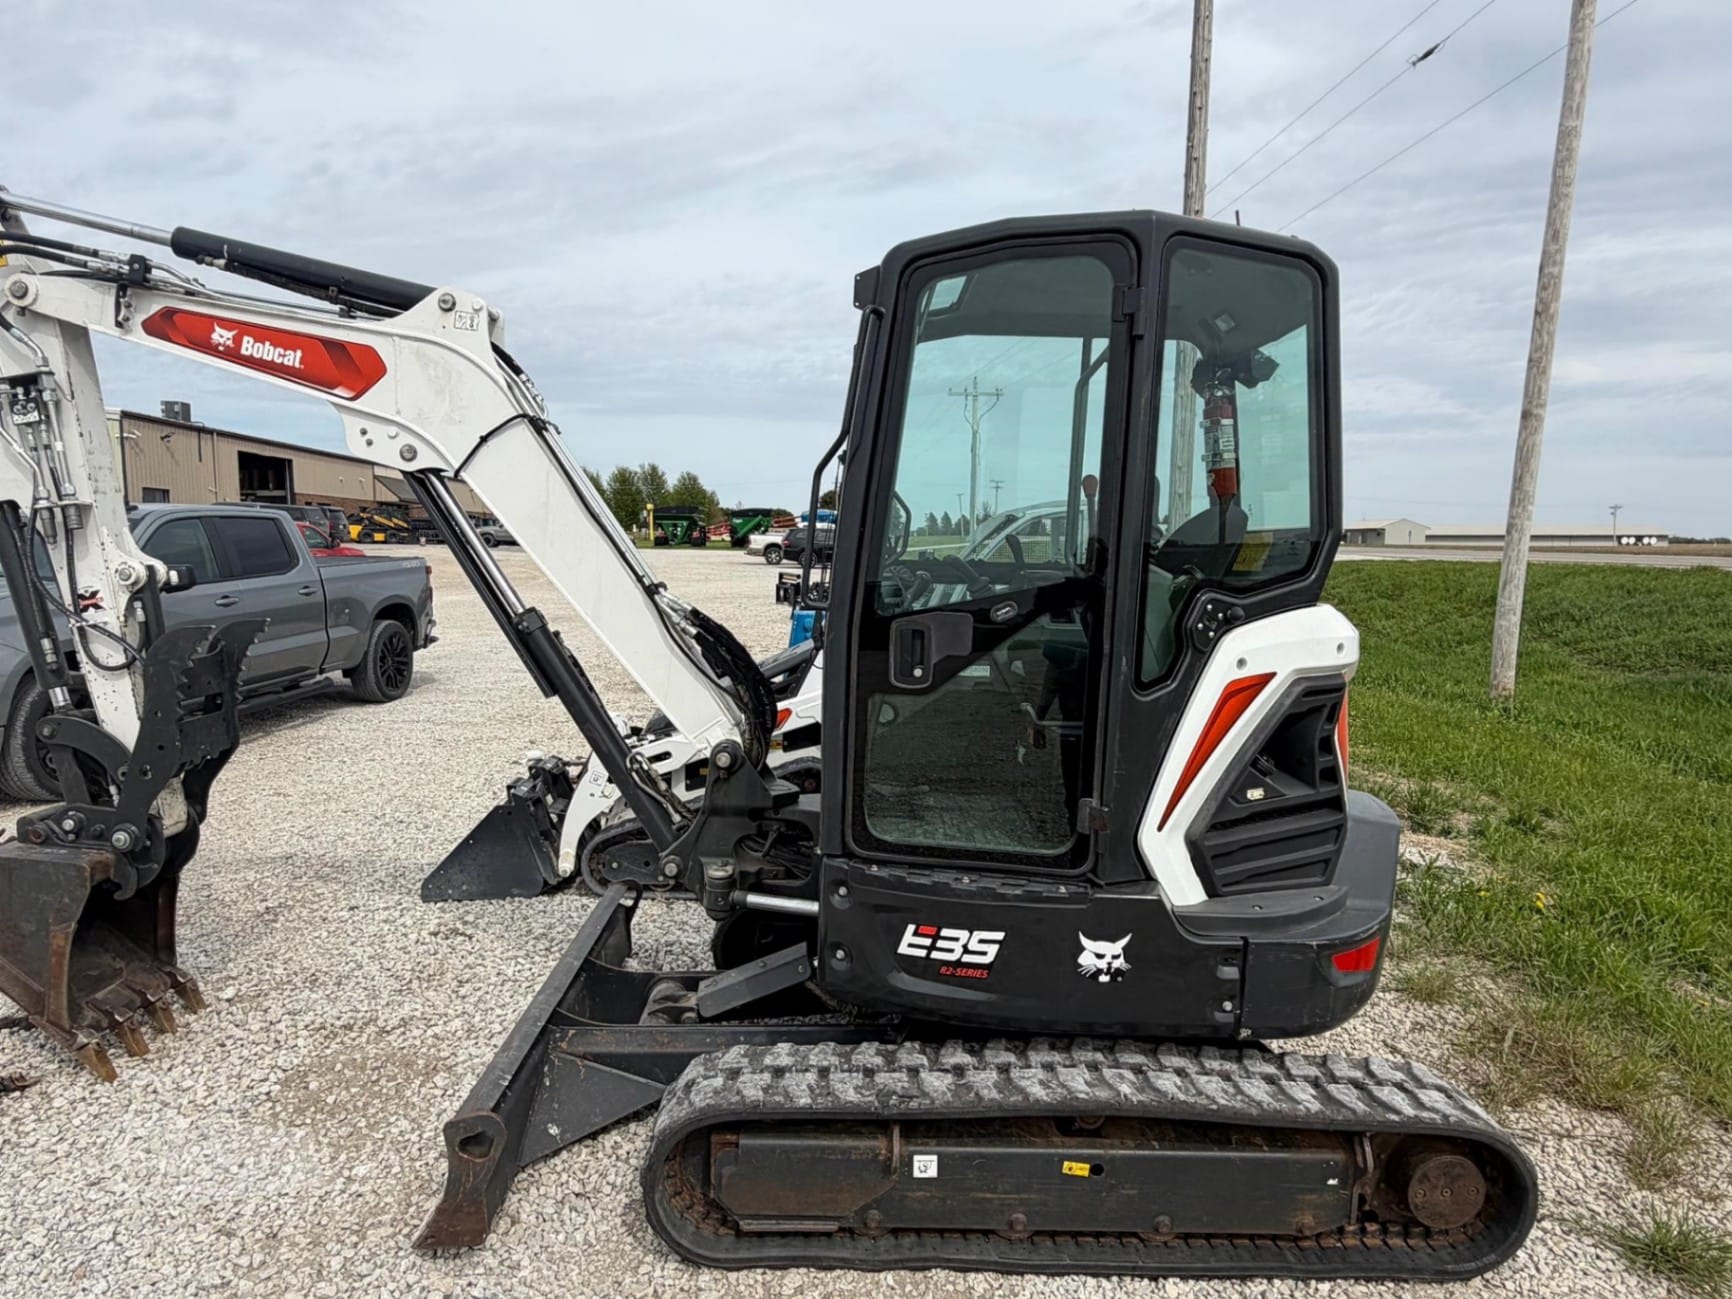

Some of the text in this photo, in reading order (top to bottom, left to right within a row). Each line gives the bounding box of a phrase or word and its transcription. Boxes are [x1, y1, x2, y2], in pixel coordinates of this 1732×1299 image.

[240, 335, 302, 368] Bobcat
[897, 923, 1006, 964] E35
[939, 966, 989, 978] R2-SERIES
